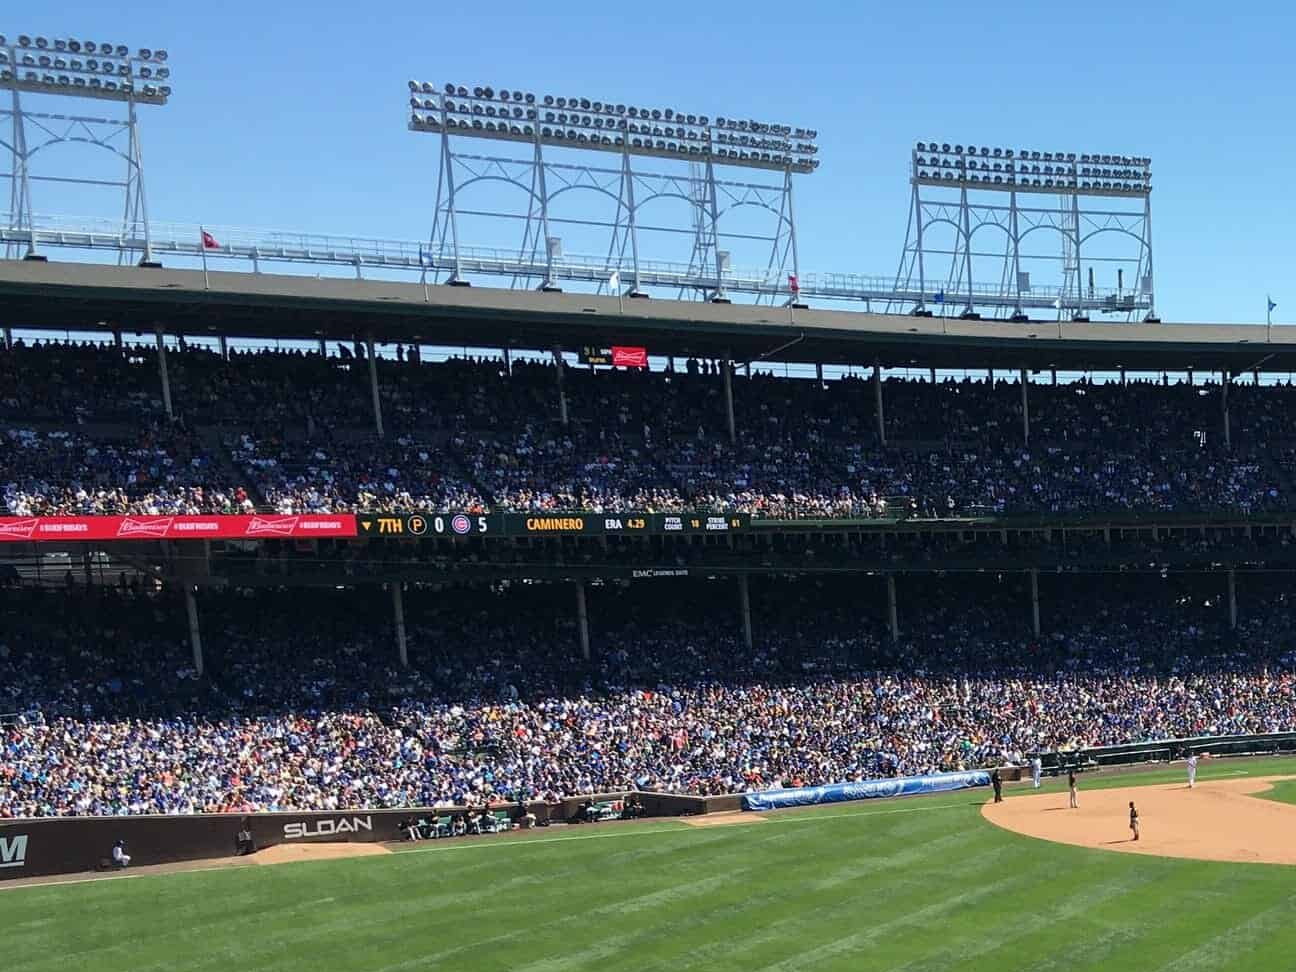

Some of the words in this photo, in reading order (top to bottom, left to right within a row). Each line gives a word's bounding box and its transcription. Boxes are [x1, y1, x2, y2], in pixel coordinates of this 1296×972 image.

[378, 519, 402, 533] 7TH
[435, 517, 444, 532] 0
[478, 517, 487, 532] 5
[527, 518, 583, 530] CAMINERO
[605, 519, 622, 529] ERA
[283, 816, 373, 838] SLOAN
